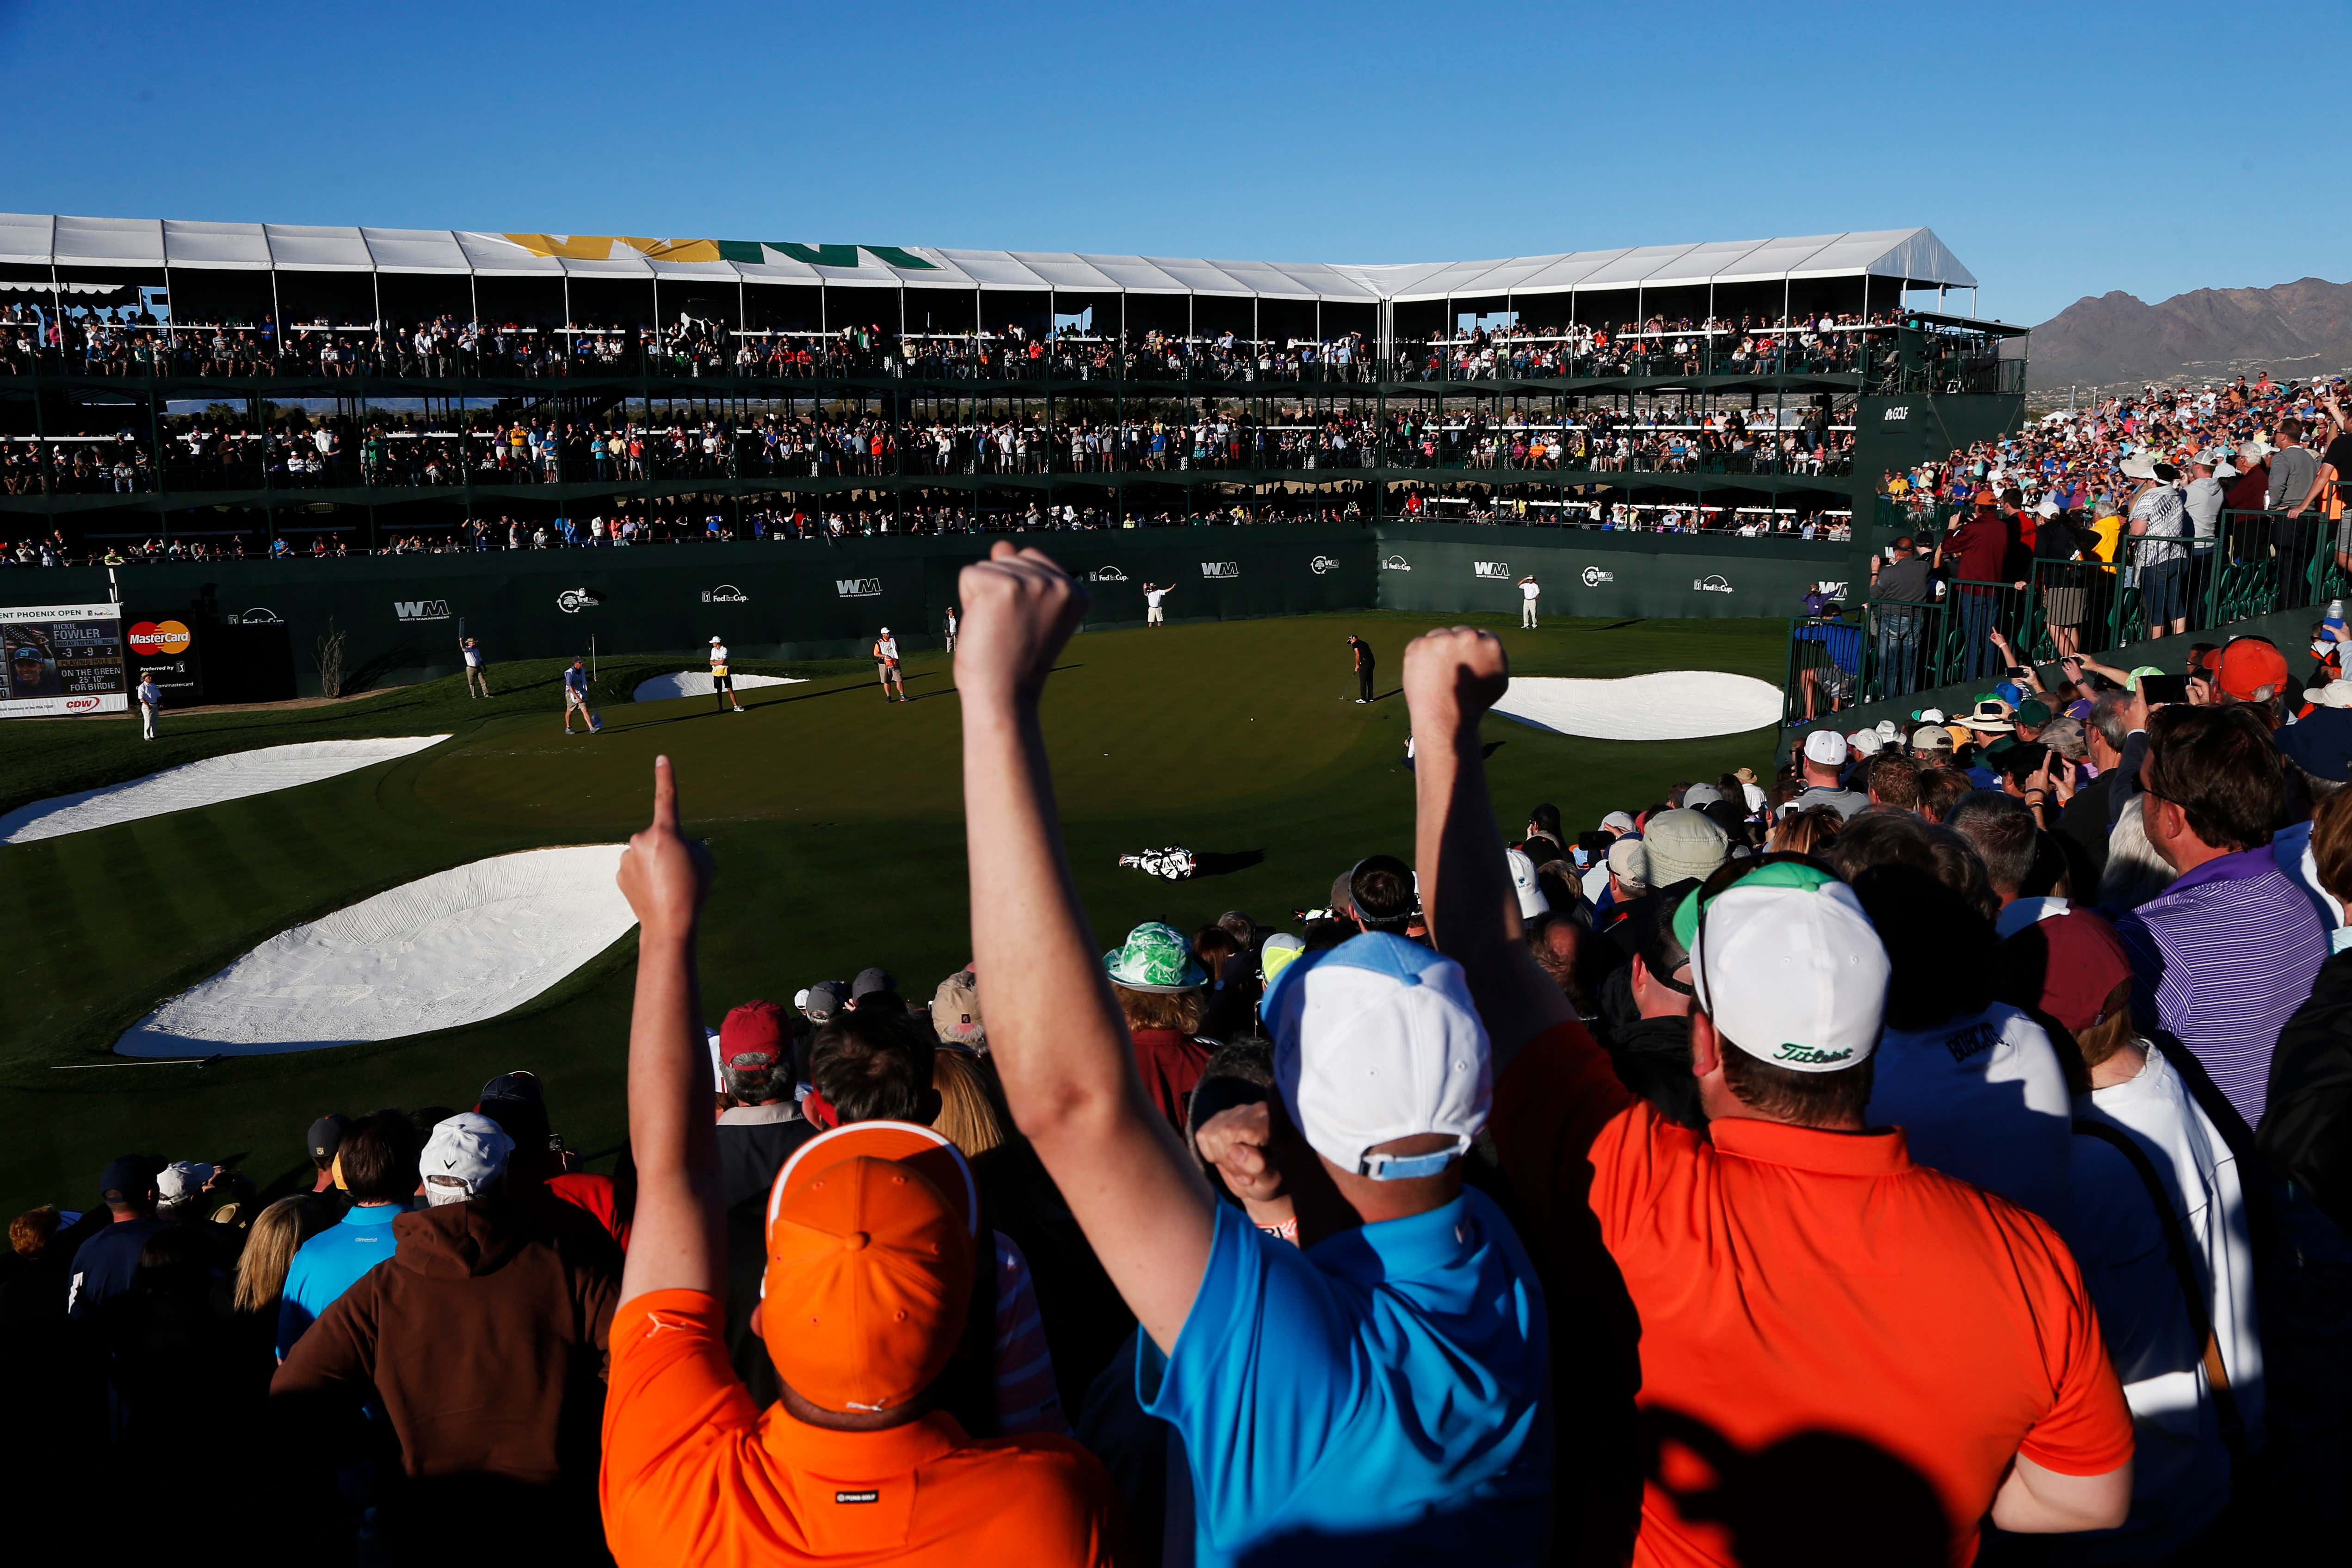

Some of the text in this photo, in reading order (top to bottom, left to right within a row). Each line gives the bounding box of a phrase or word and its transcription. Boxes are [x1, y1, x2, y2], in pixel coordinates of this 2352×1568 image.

[1893, 407, 1909, 420] GOLF
[1201, 562, 1238, 575] WM
[1389, 563, 1411, 572] FedExCup
[1474, 562, 1509, 576] WM
[836, 578, 881, 594] WM
[1703, 584, 1733, 594] FedExCup
[713, 594, 747, 603] FedExCup
[394, 600, 449, 617] WM
[54, 629, 100, 639] FOWLER
[130, 631, 189, 644] MasterCard
[62, 648, 72, 657] -3
[83, 648, 93, 656] -9
[88, 682, 116, 690] BIRDIE
[66, 700, 93, 709] CDW
